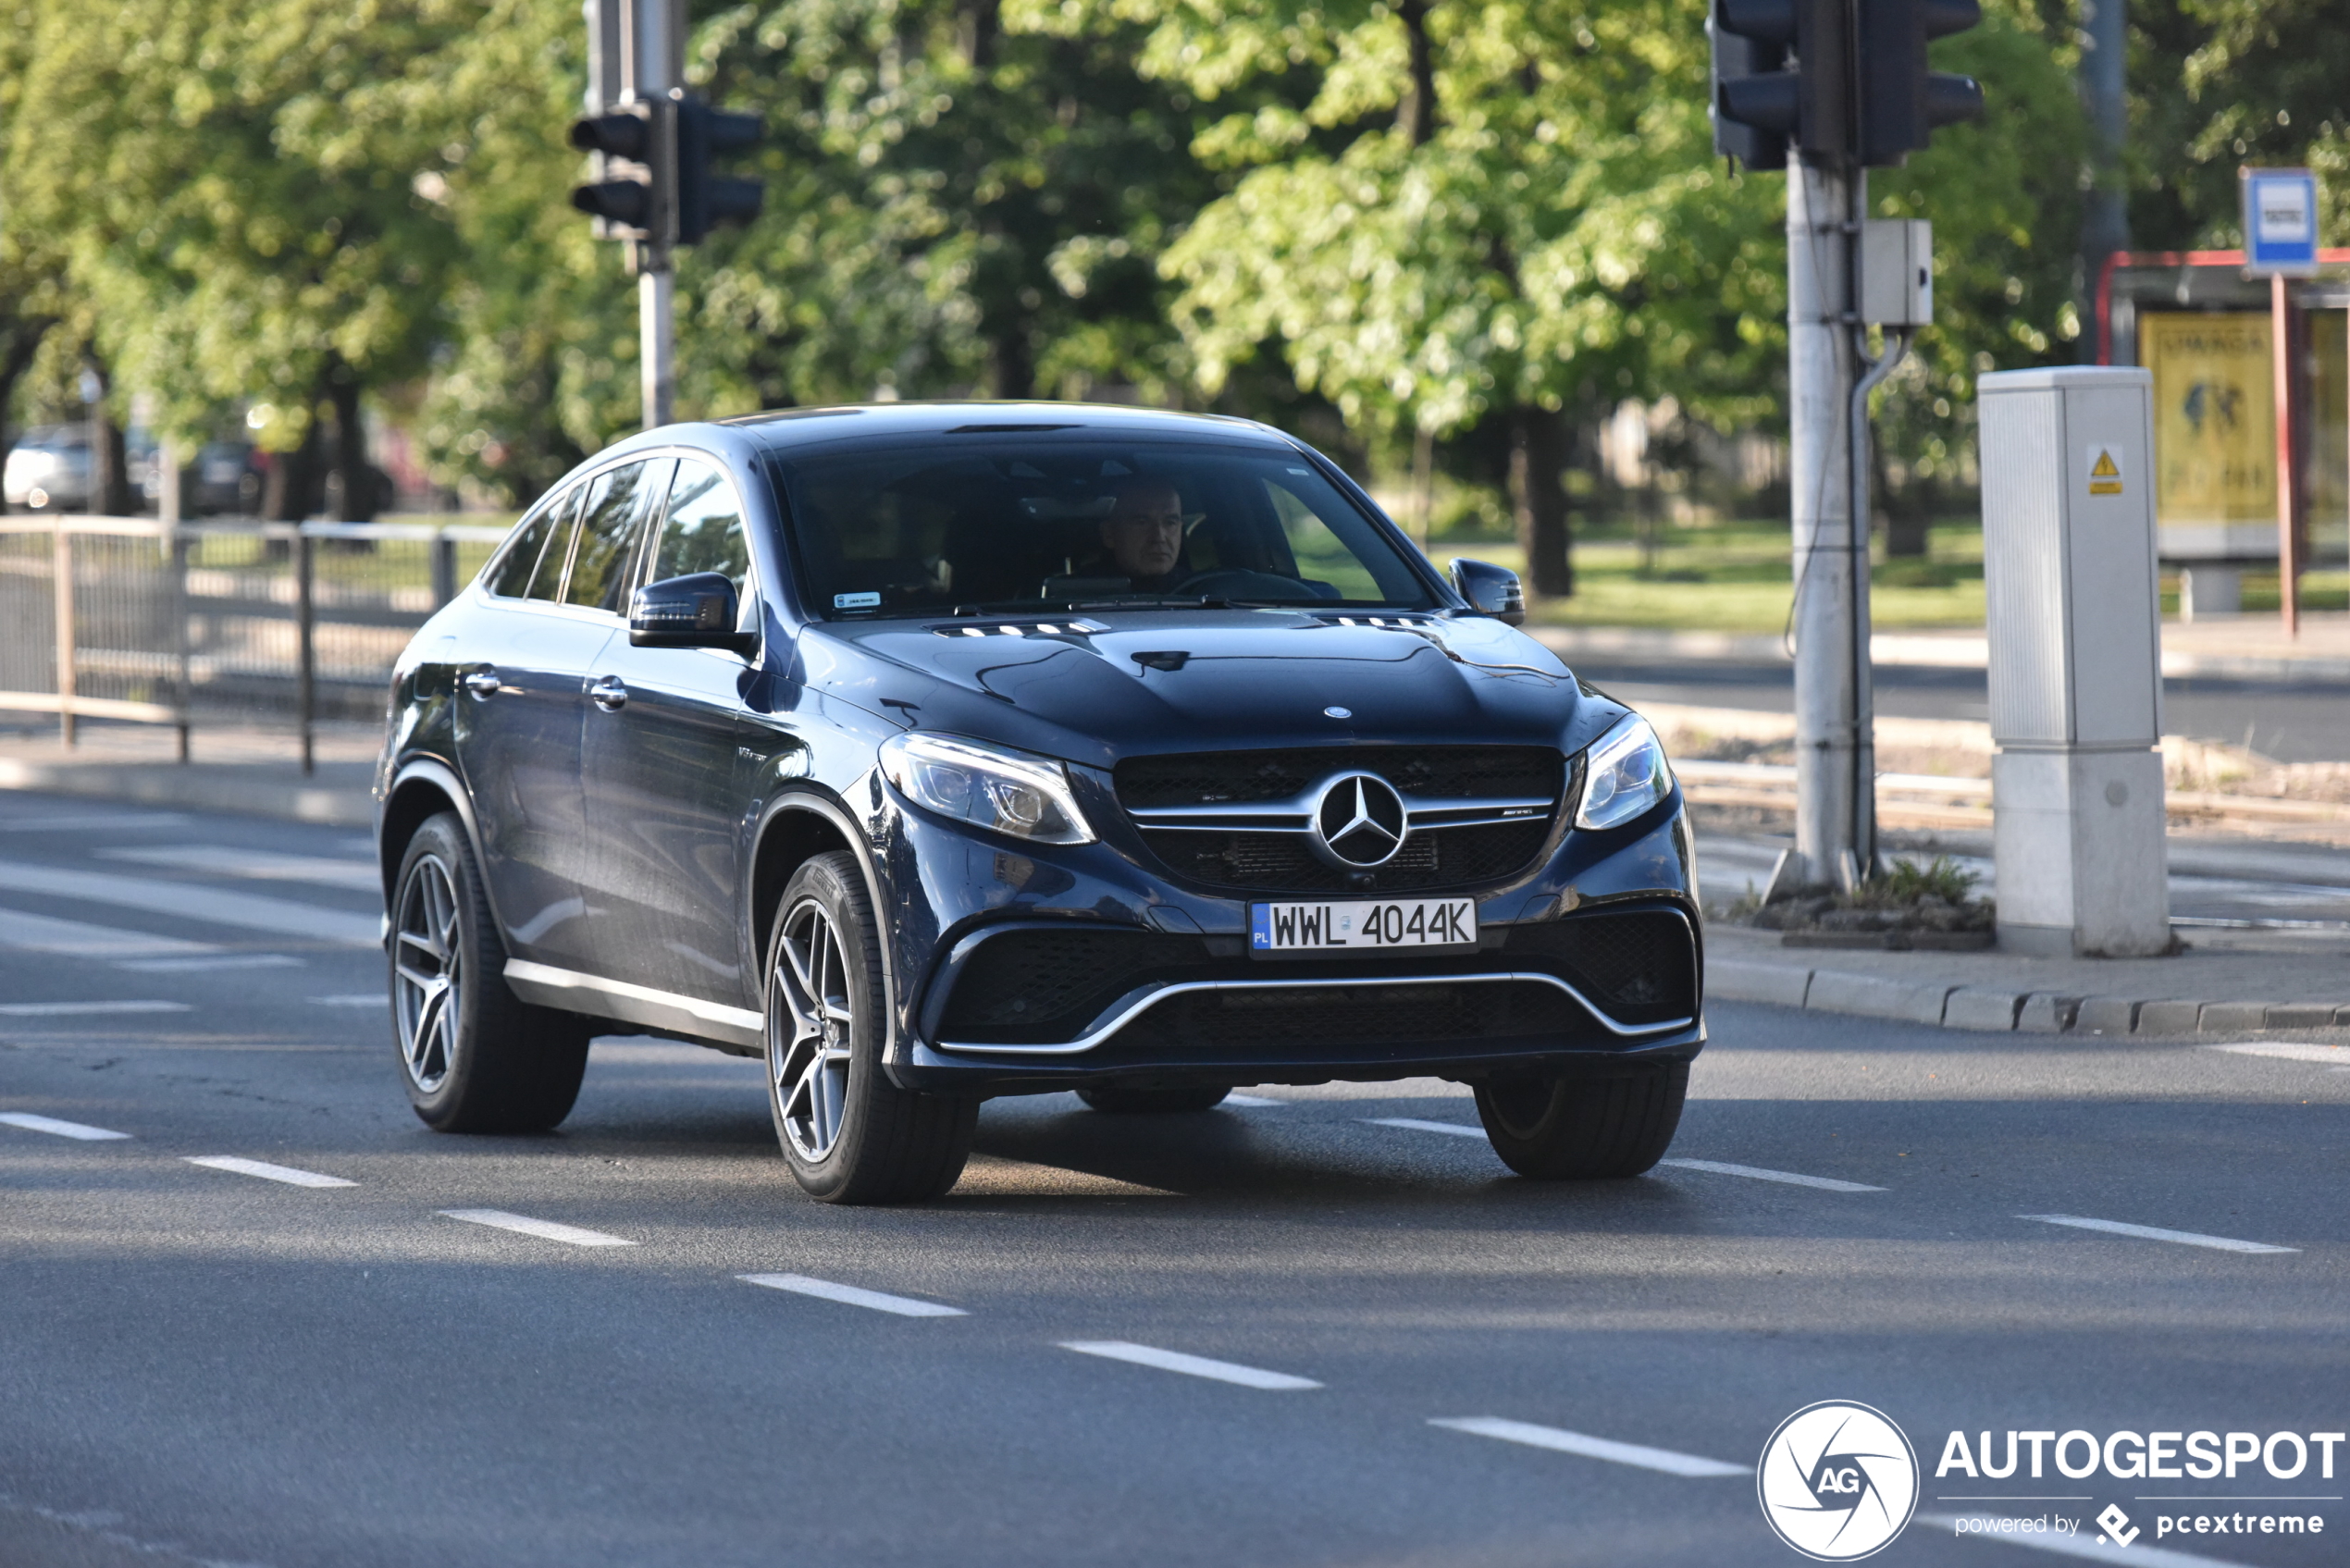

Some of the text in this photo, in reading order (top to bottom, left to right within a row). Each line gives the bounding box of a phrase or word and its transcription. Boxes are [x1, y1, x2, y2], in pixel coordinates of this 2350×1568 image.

[812, 867, 836, 899] PIRELLI
[1254, 932, 1268, 944] PL
[1273, 902, 1470, 945] WWL 4044K
